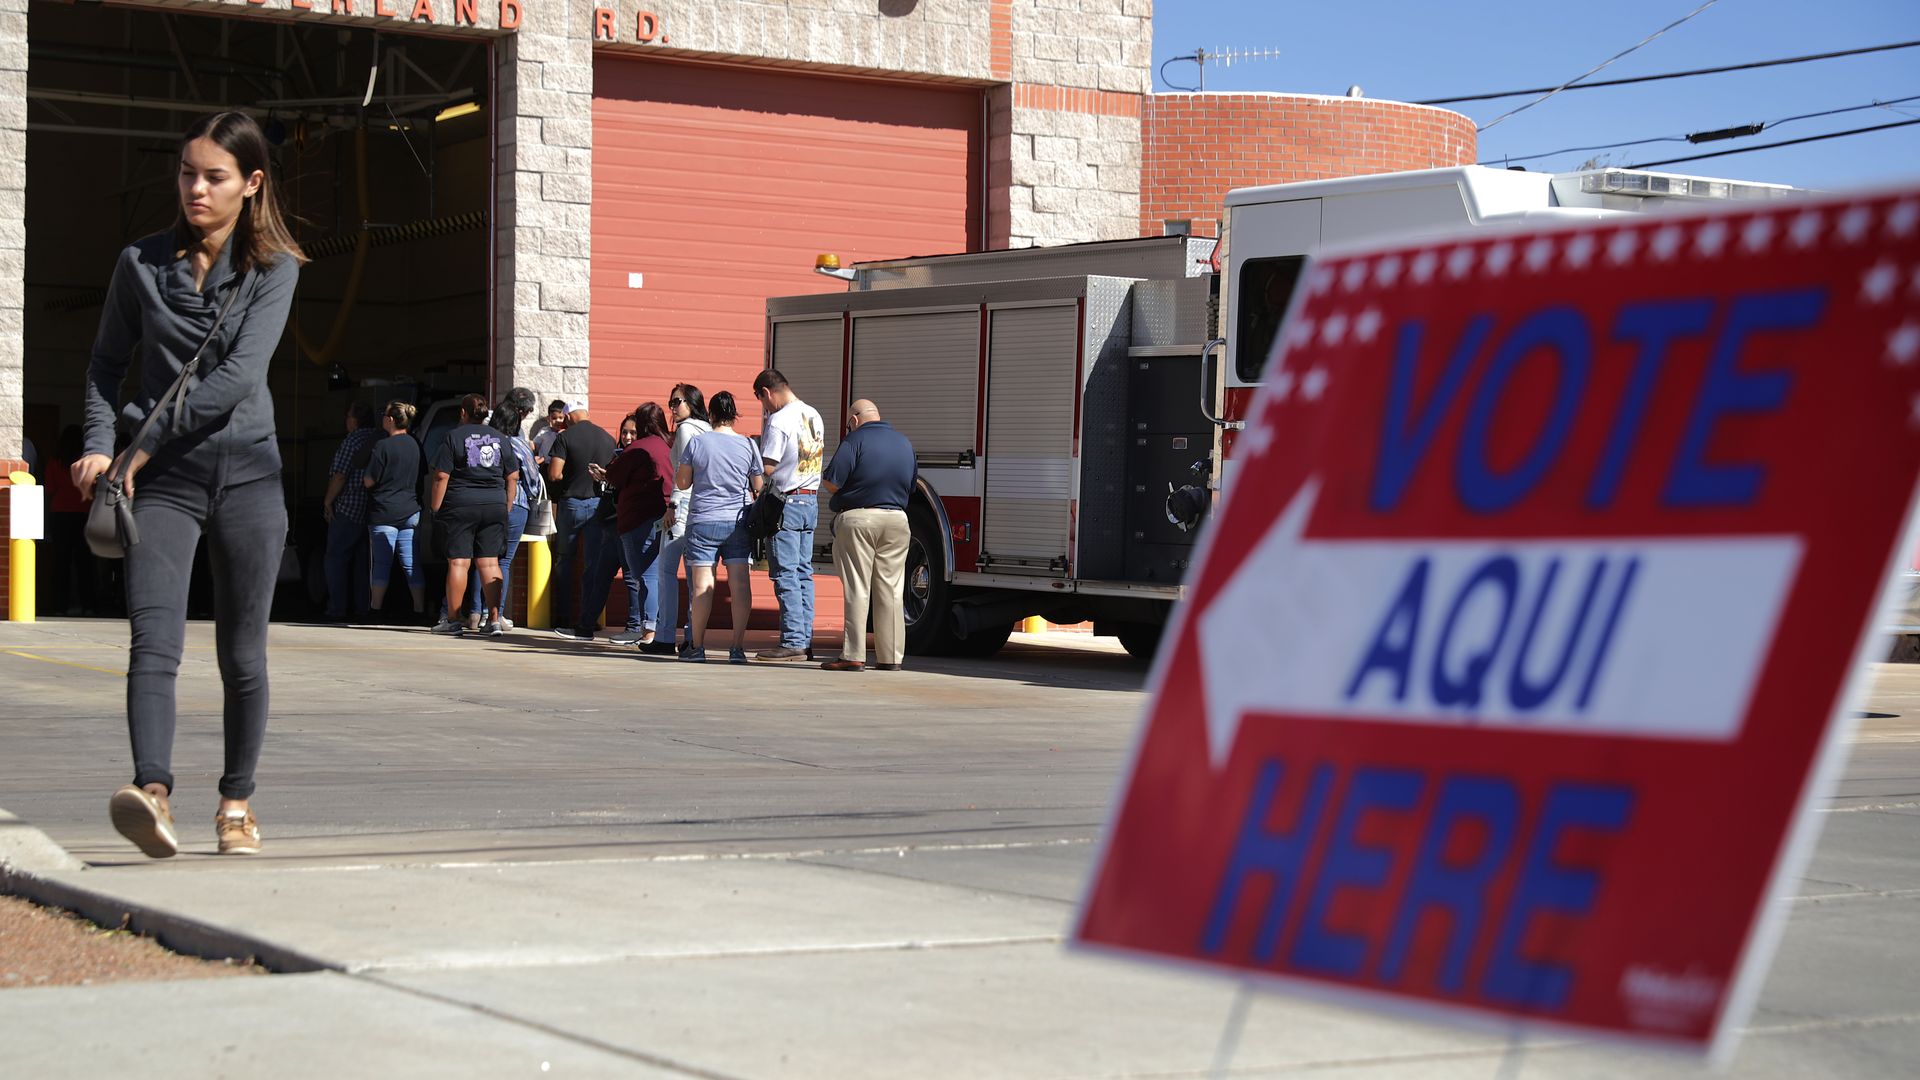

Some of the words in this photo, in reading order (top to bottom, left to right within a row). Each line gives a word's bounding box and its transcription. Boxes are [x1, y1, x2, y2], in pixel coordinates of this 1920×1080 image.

[595, 8, 670, 43] RD.
[1370, 288, 1828, 514] VOTE
[1345, 555, 1642, 712] AQUI
[1202, 758, 1636, 1012] HERE
